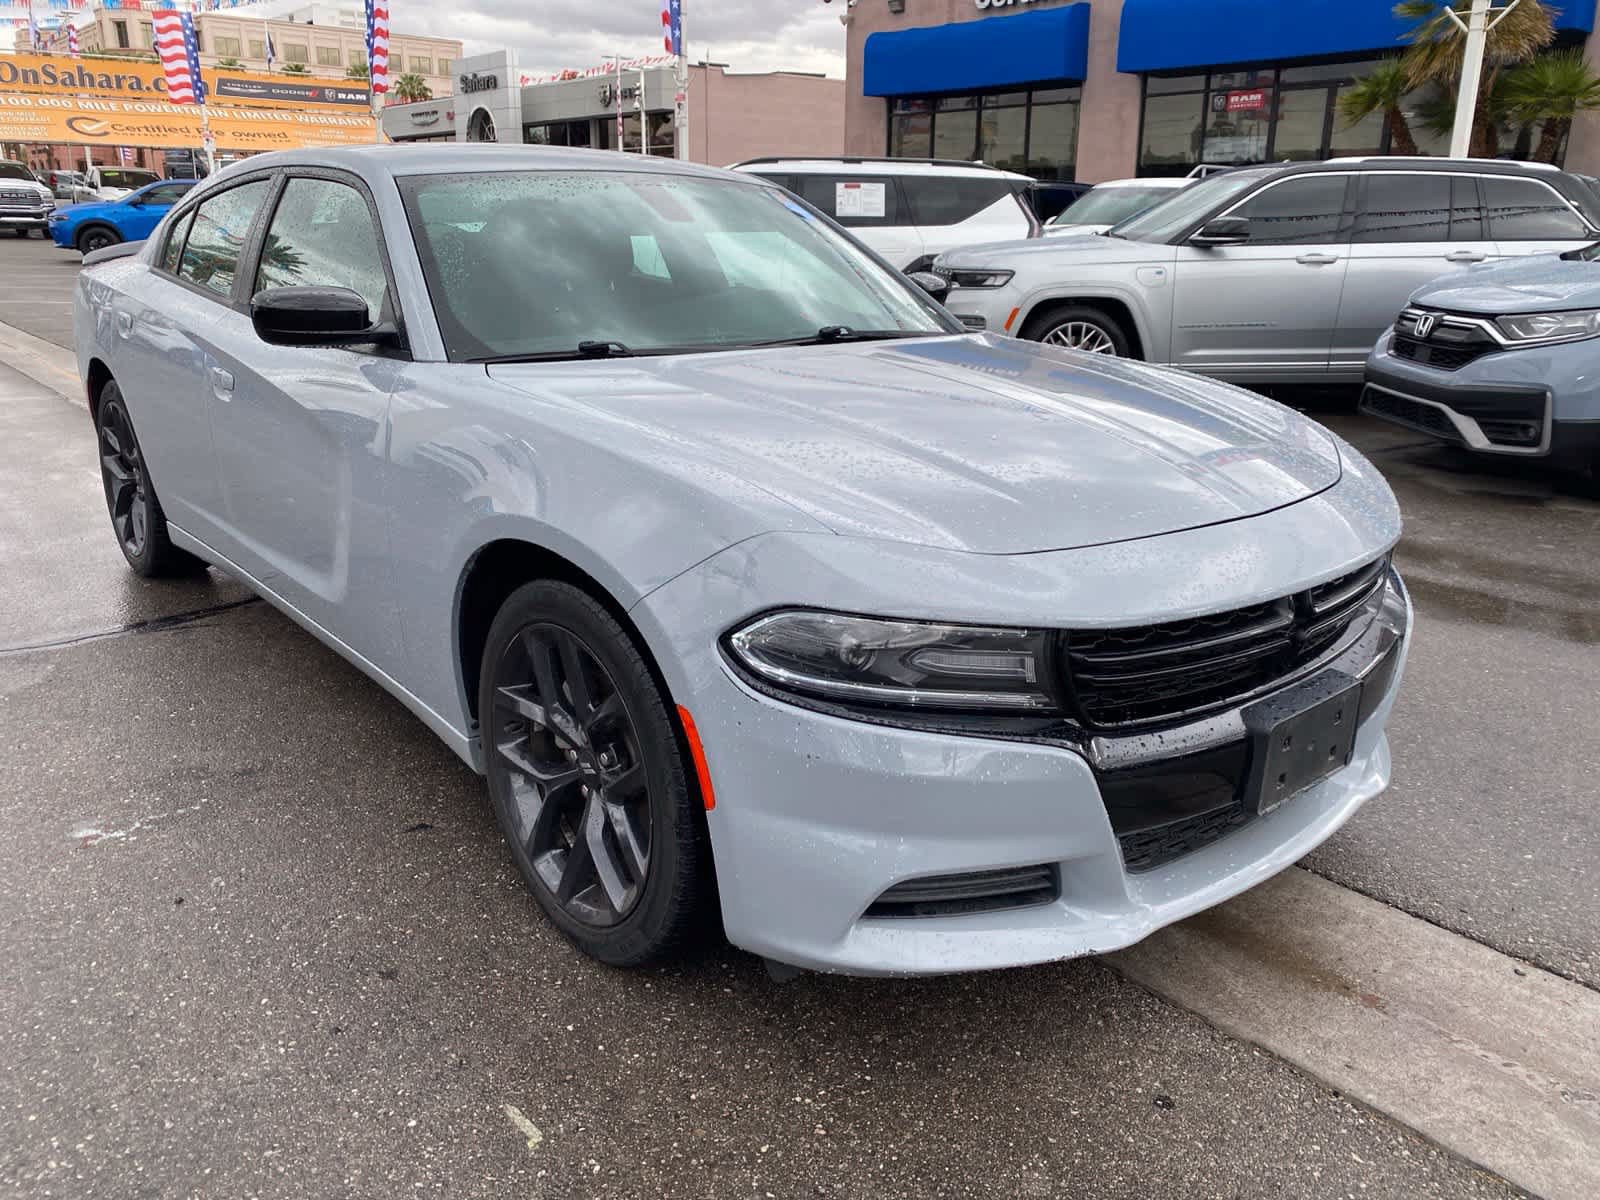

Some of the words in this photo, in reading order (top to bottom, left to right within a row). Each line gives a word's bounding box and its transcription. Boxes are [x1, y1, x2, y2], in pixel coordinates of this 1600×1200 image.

[0, 61, 209, 96] OnSahara.c
[460, 73, 498, 94] Sahara
[337, 92, 367, 101] RAM
[1230, 94, 1262, 102] RAM
[78, 100, 119, 112] MILE
[231, 109, 292, 121] LIMITED
[294, 113, 371, 127] WARRANTY
[110, 123, 190, 134] Certified
[231, 129, 289, 140] owned
